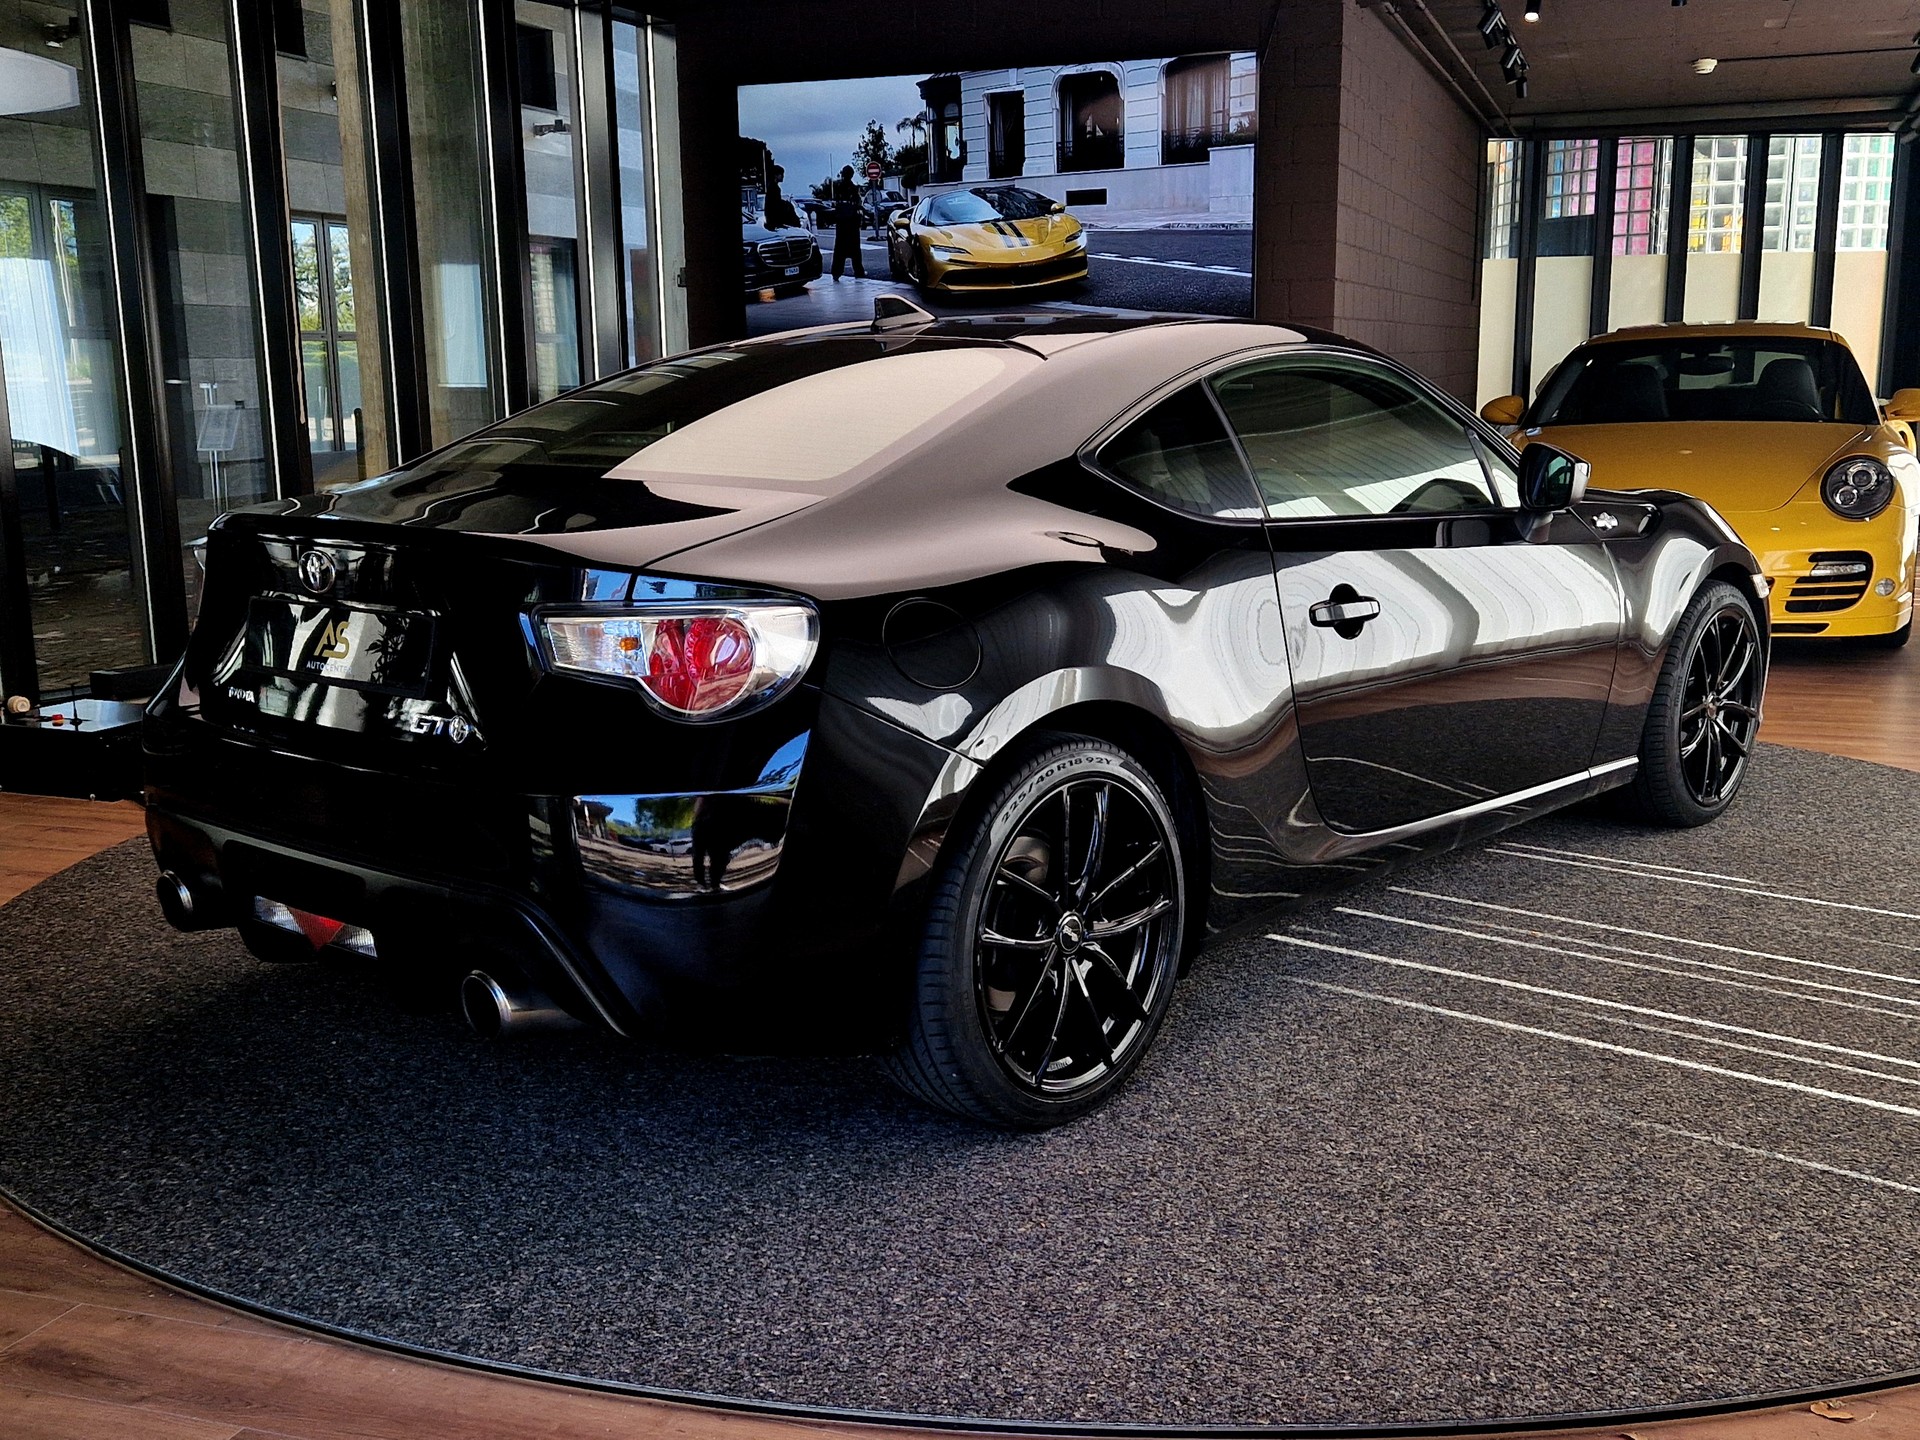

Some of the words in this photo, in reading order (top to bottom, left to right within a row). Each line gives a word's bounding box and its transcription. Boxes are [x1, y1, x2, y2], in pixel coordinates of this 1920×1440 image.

[314, 619, 350, 659] AS
[306, 660, 352, 675] AUTOCENTER
[1056, 757, 1083, 772] R18
